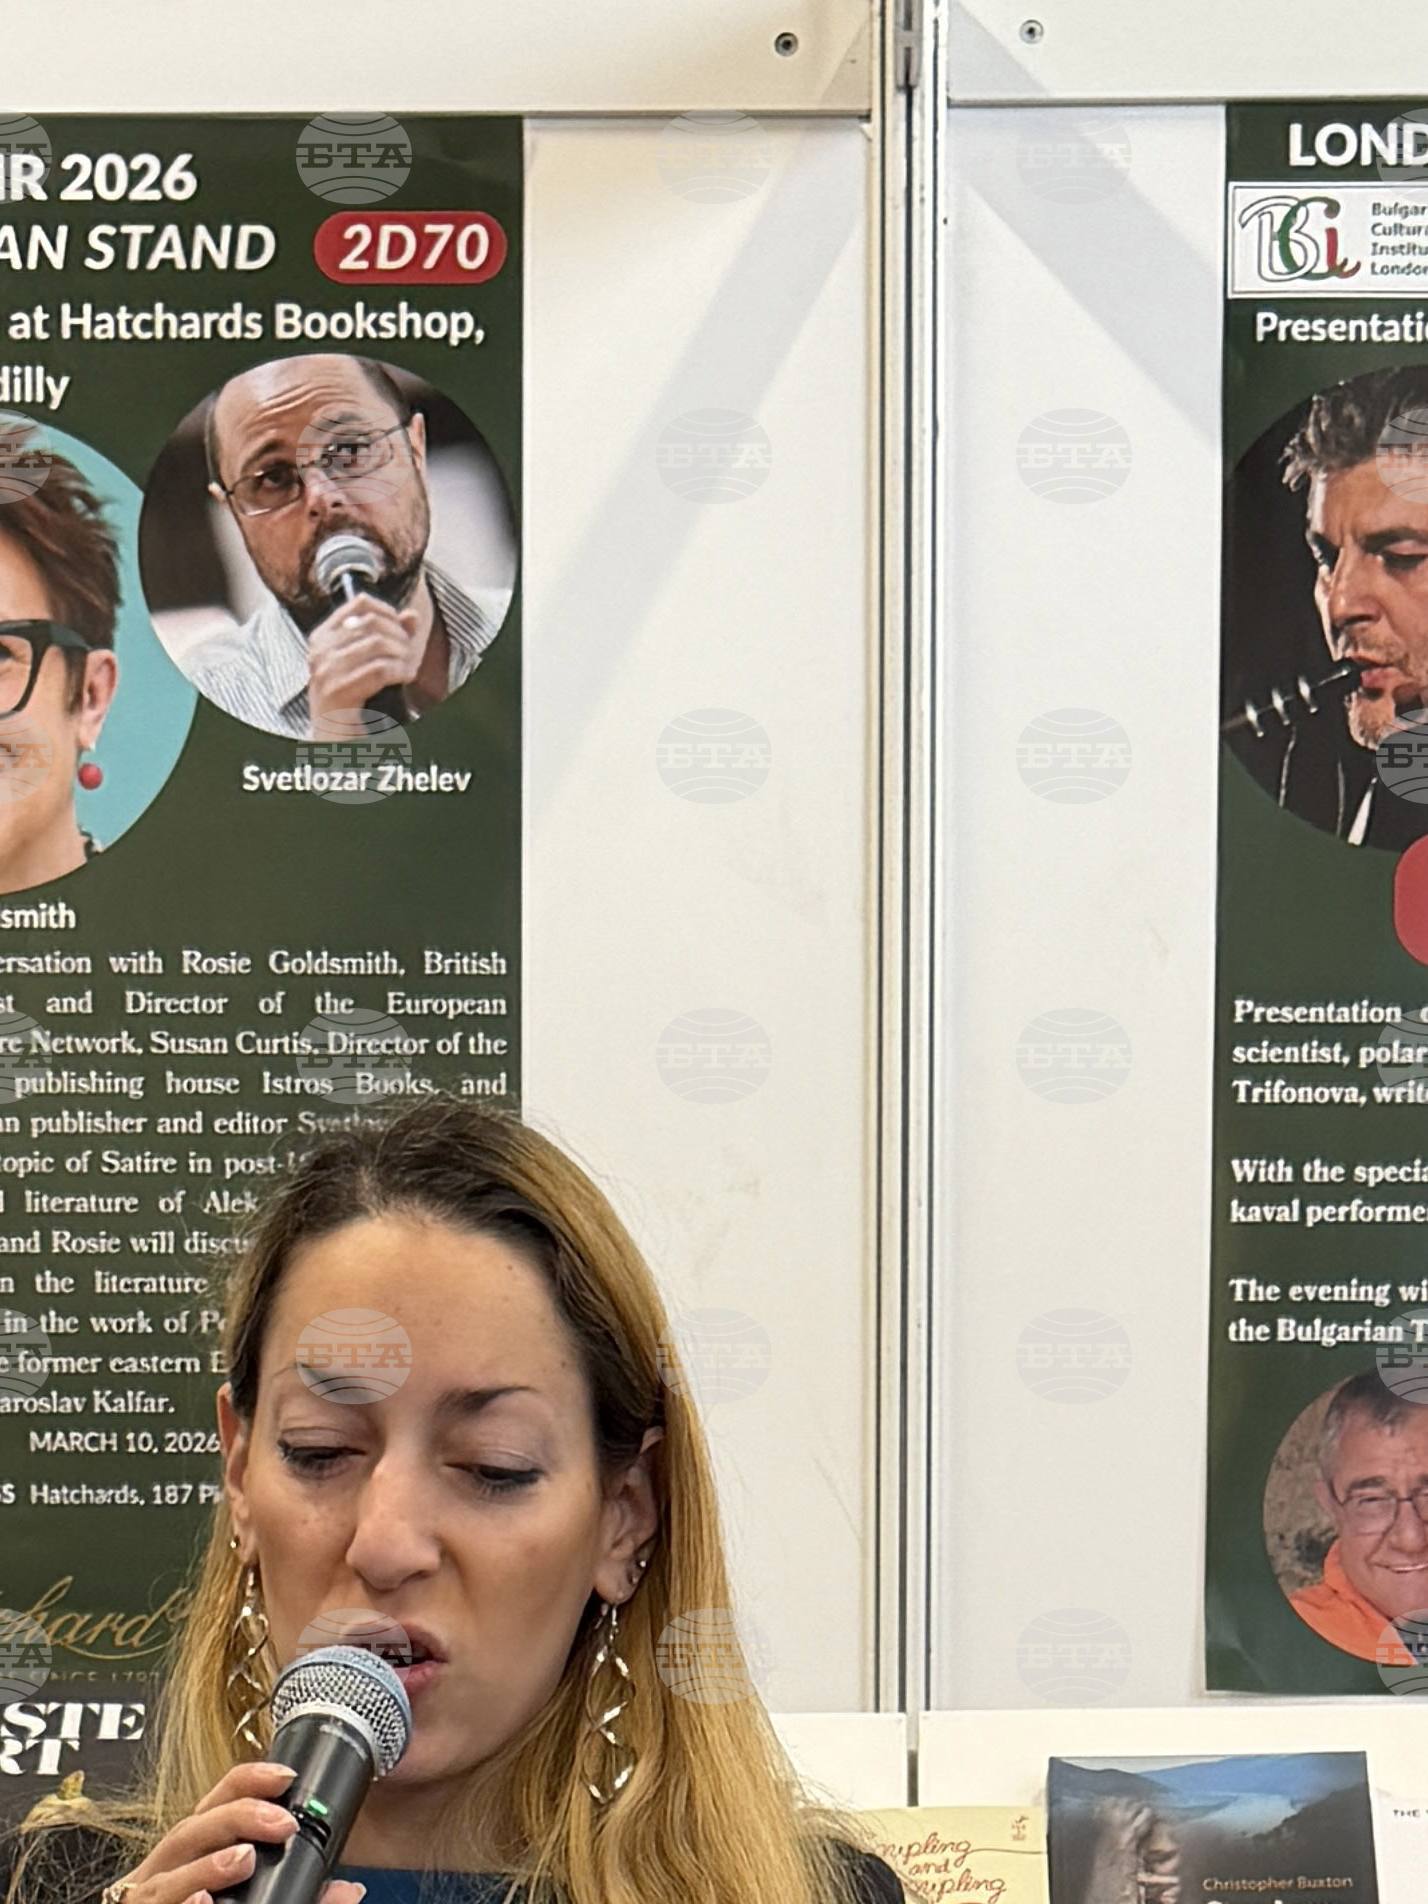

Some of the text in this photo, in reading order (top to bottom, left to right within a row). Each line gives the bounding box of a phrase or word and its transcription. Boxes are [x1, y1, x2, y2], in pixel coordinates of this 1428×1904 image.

[60, 153, 197, 201] 2026
[84, 224, 275, 270] STAND
[339, 224, 489, 269] 2D70
[8, 305, 50, 340] at
[61, 302, 263, 340] Hatchards
[275, 301, 485, 346] Bookshop,
[242, 764, 472, 792] Svetlozar Zhelev
[108, 950, 163, 974] with
[181, 949, 252, 974] Rosie
[268, 950, 406, 976] Goldsmith,
[424, 950, 507, 975] British
[1230, 1198, 1300, 1223] kaval
[29, 1431, 221, 1454] MARCH 10, 2026
[30, 1483, 193, 1506] Hatchards, 187
[1203, 1875, 1353, 1892] Christopher Buxton
